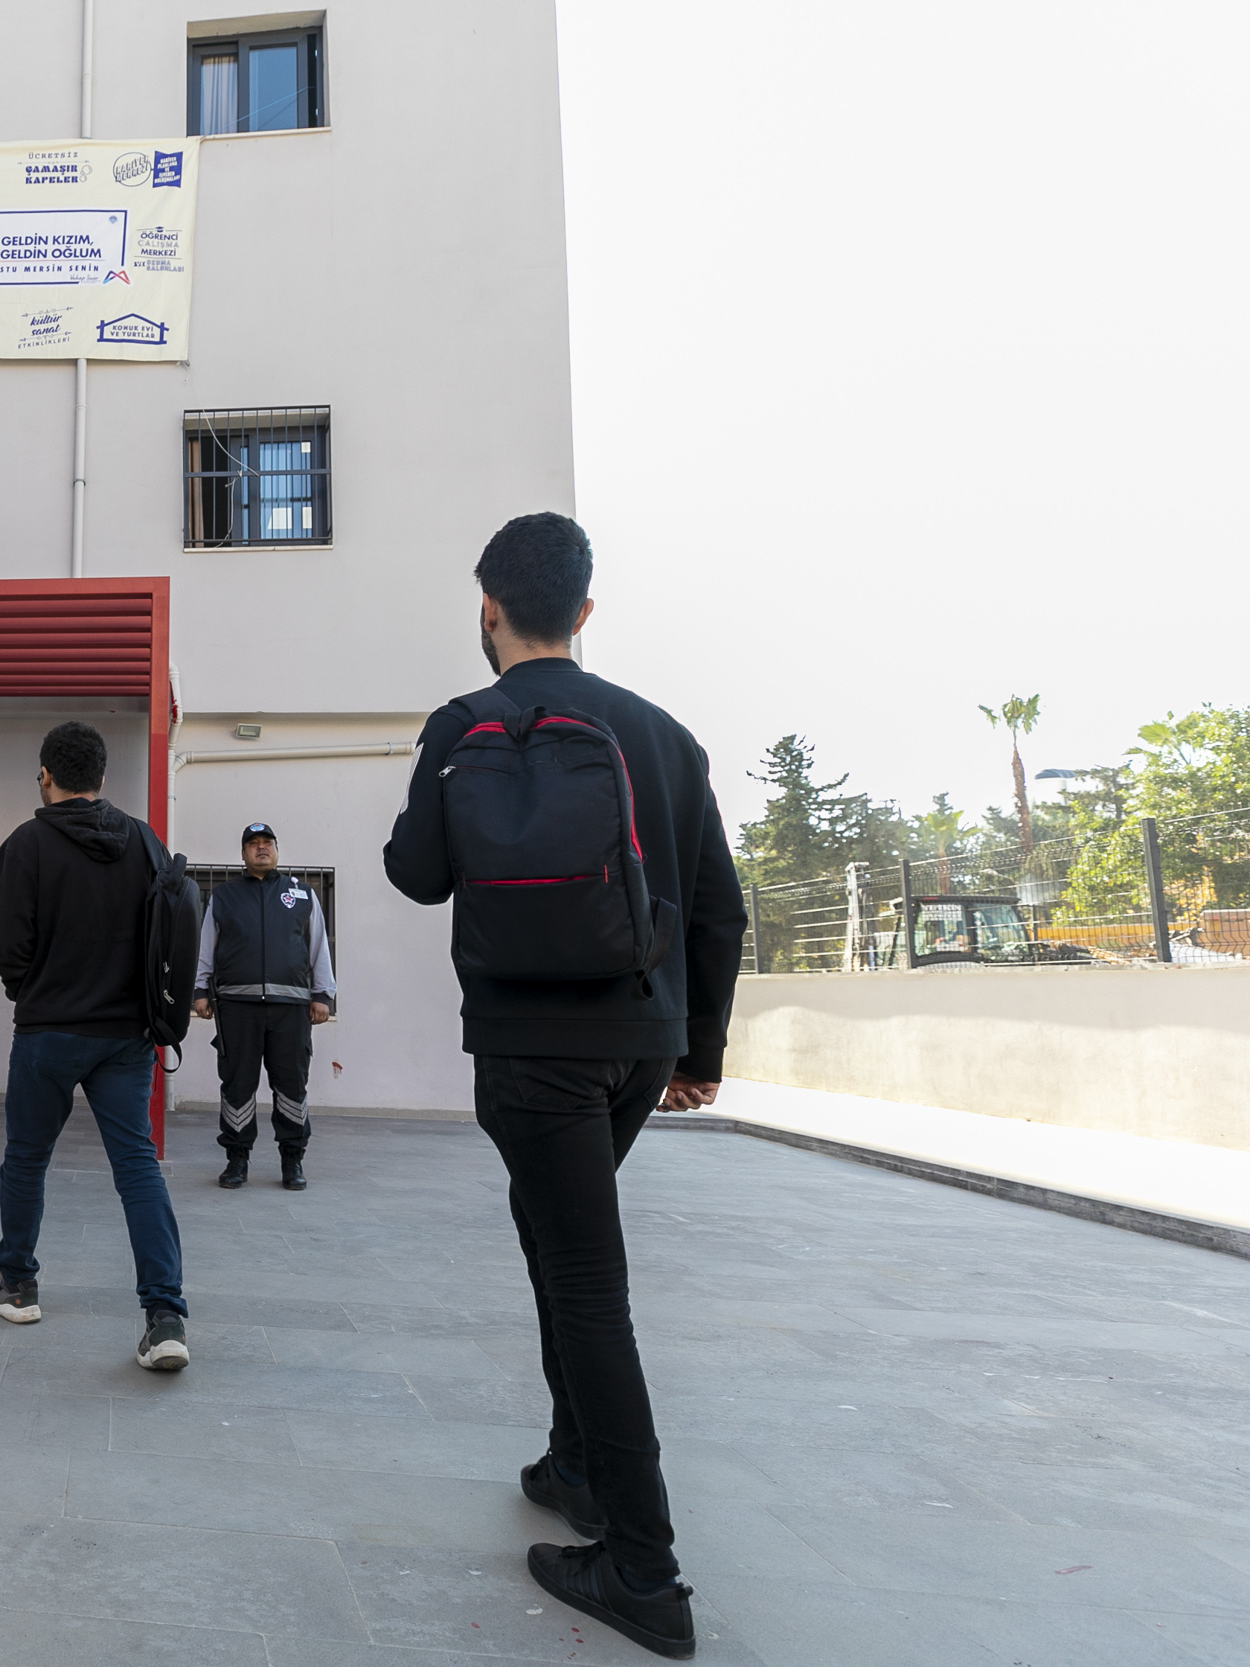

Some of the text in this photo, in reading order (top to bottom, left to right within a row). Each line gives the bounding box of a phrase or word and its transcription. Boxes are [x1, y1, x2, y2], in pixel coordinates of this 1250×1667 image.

[28, 151, 78, 160] ÜCRETSİZ
[25, 165, 78, 176] ÇAMAŞIR
[25, 176, 78, 184] KAFELER
[1, 233, 48, 246] GELDİN
[52, 235, 94, 246] KIZIM,
[140, 231, 179, 241] ÖĞRENCİ
[138, 240, 179, 248] ÇALIŞMA
[0, 246, 47, 259] GELDİN
[51, 246, 102, 259] OĞLUM
[141, 247, 176, 256] MERKEZİ
[24, 263, 62, 272] MERSİN
[69, 264, 99, 272] SENİN
[30, 313, 62, 326] kültür
[32, 324, 61, 336] sanat
[18, 336, 70, 349] ETKİNLİKLERİ
